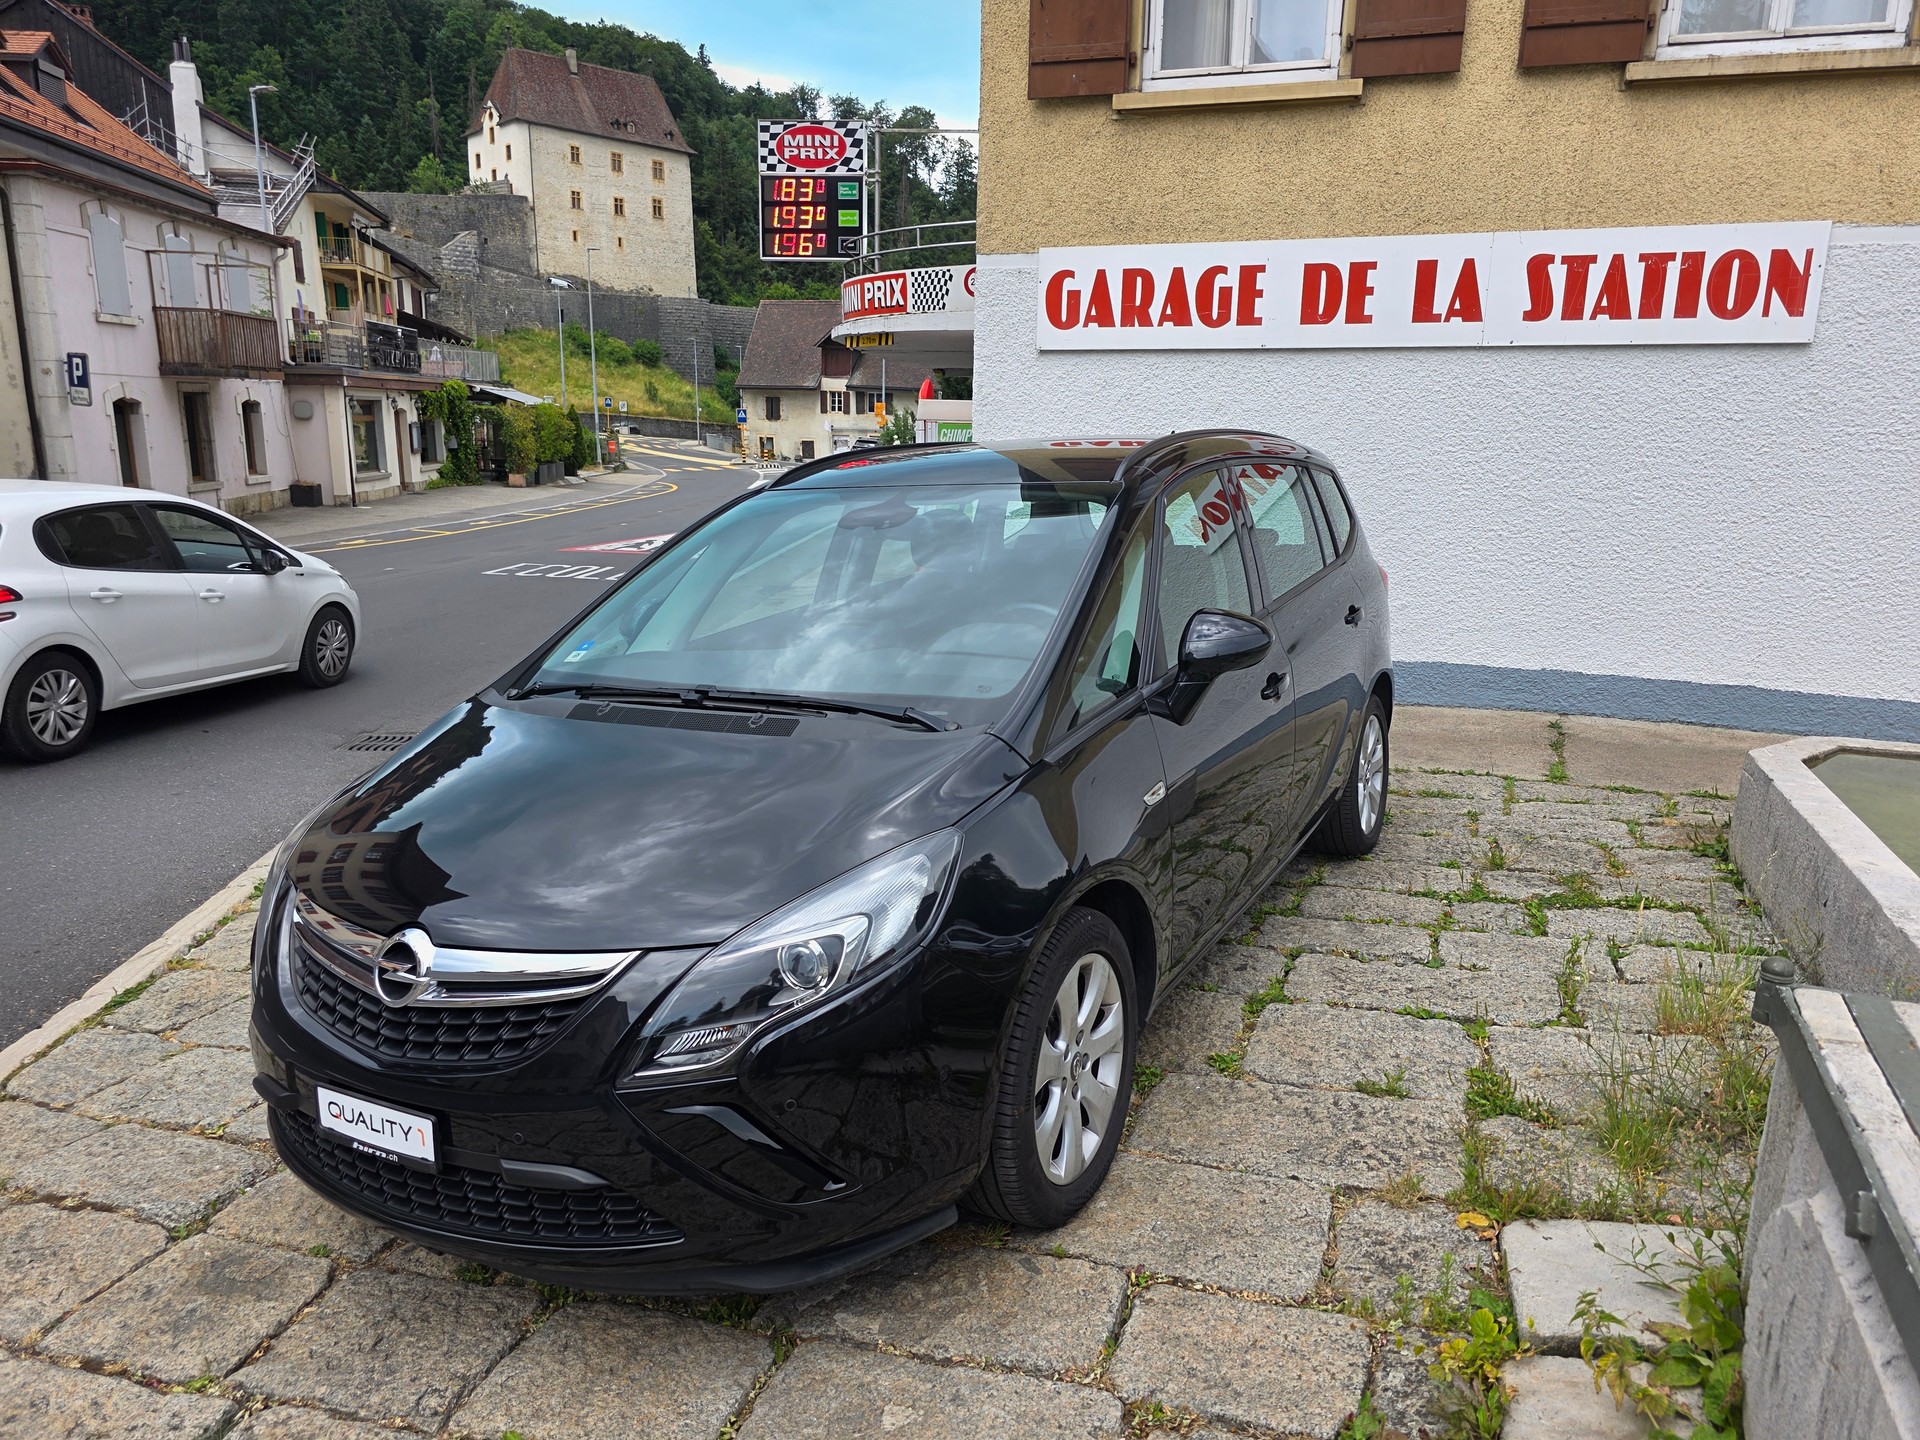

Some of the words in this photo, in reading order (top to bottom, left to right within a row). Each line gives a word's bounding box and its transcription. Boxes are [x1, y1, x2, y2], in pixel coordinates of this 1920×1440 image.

[783, 134, 839, 147] MINI
[783, 147, 840, 160] PRIX
[843, 283, 861, 314] MINI
[864, 277, 905, 311] PRIX
[1044, 264, 1267, 331] GARAGE
[1300, 261, 1378, 325] DE
[1411, 258, 1484, 324] LA
[1522, 247, 1814, 322] STATION
[73, 358, 82, 384] P
[352, 1141, 399, 1163] hirn.ch
